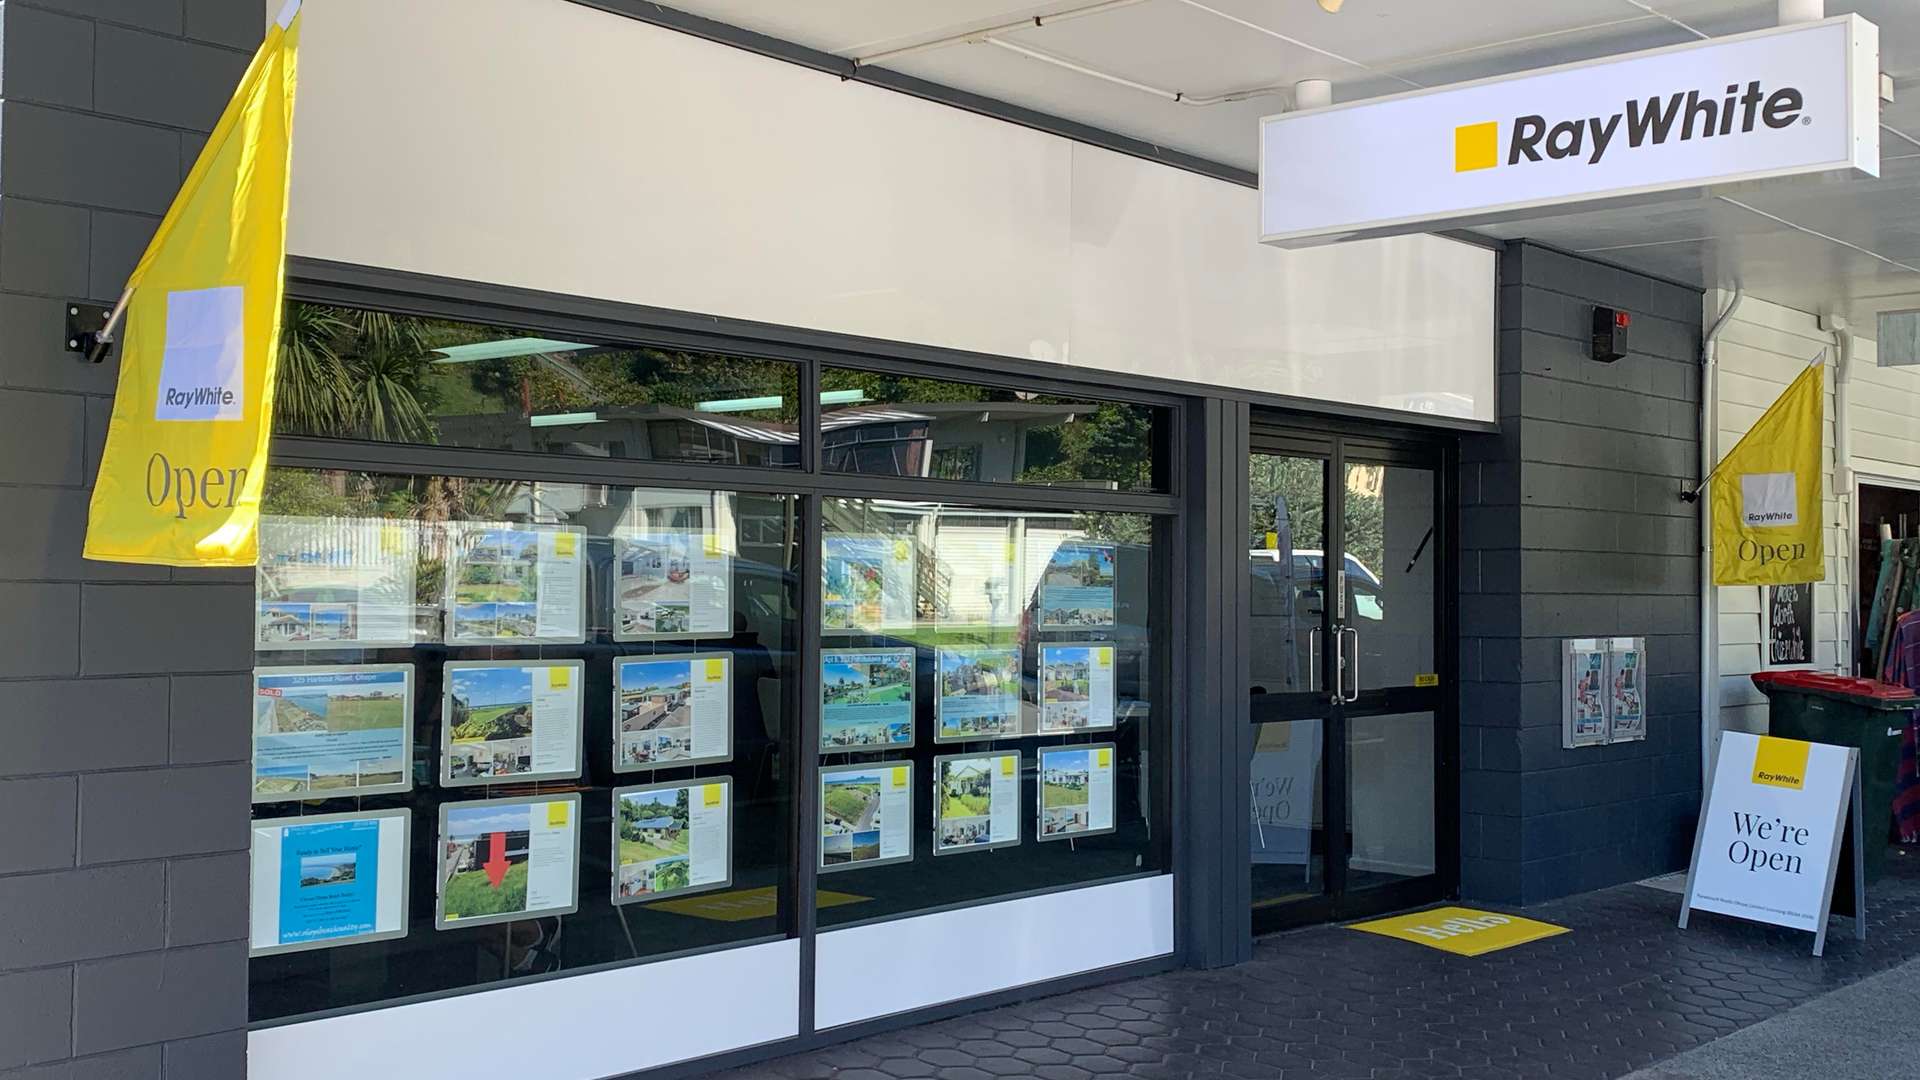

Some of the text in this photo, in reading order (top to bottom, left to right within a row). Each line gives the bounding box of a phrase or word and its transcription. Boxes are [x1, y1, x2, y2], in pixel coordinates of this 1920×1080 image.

[1738, 539, 1806, 566] Open
[259, 688, 281, 697] SOLD
[1733, 811, 1809, 846] We're
[1728, 840, 1803, 875] Open
[1404, 916, 1511, 940] Hello
